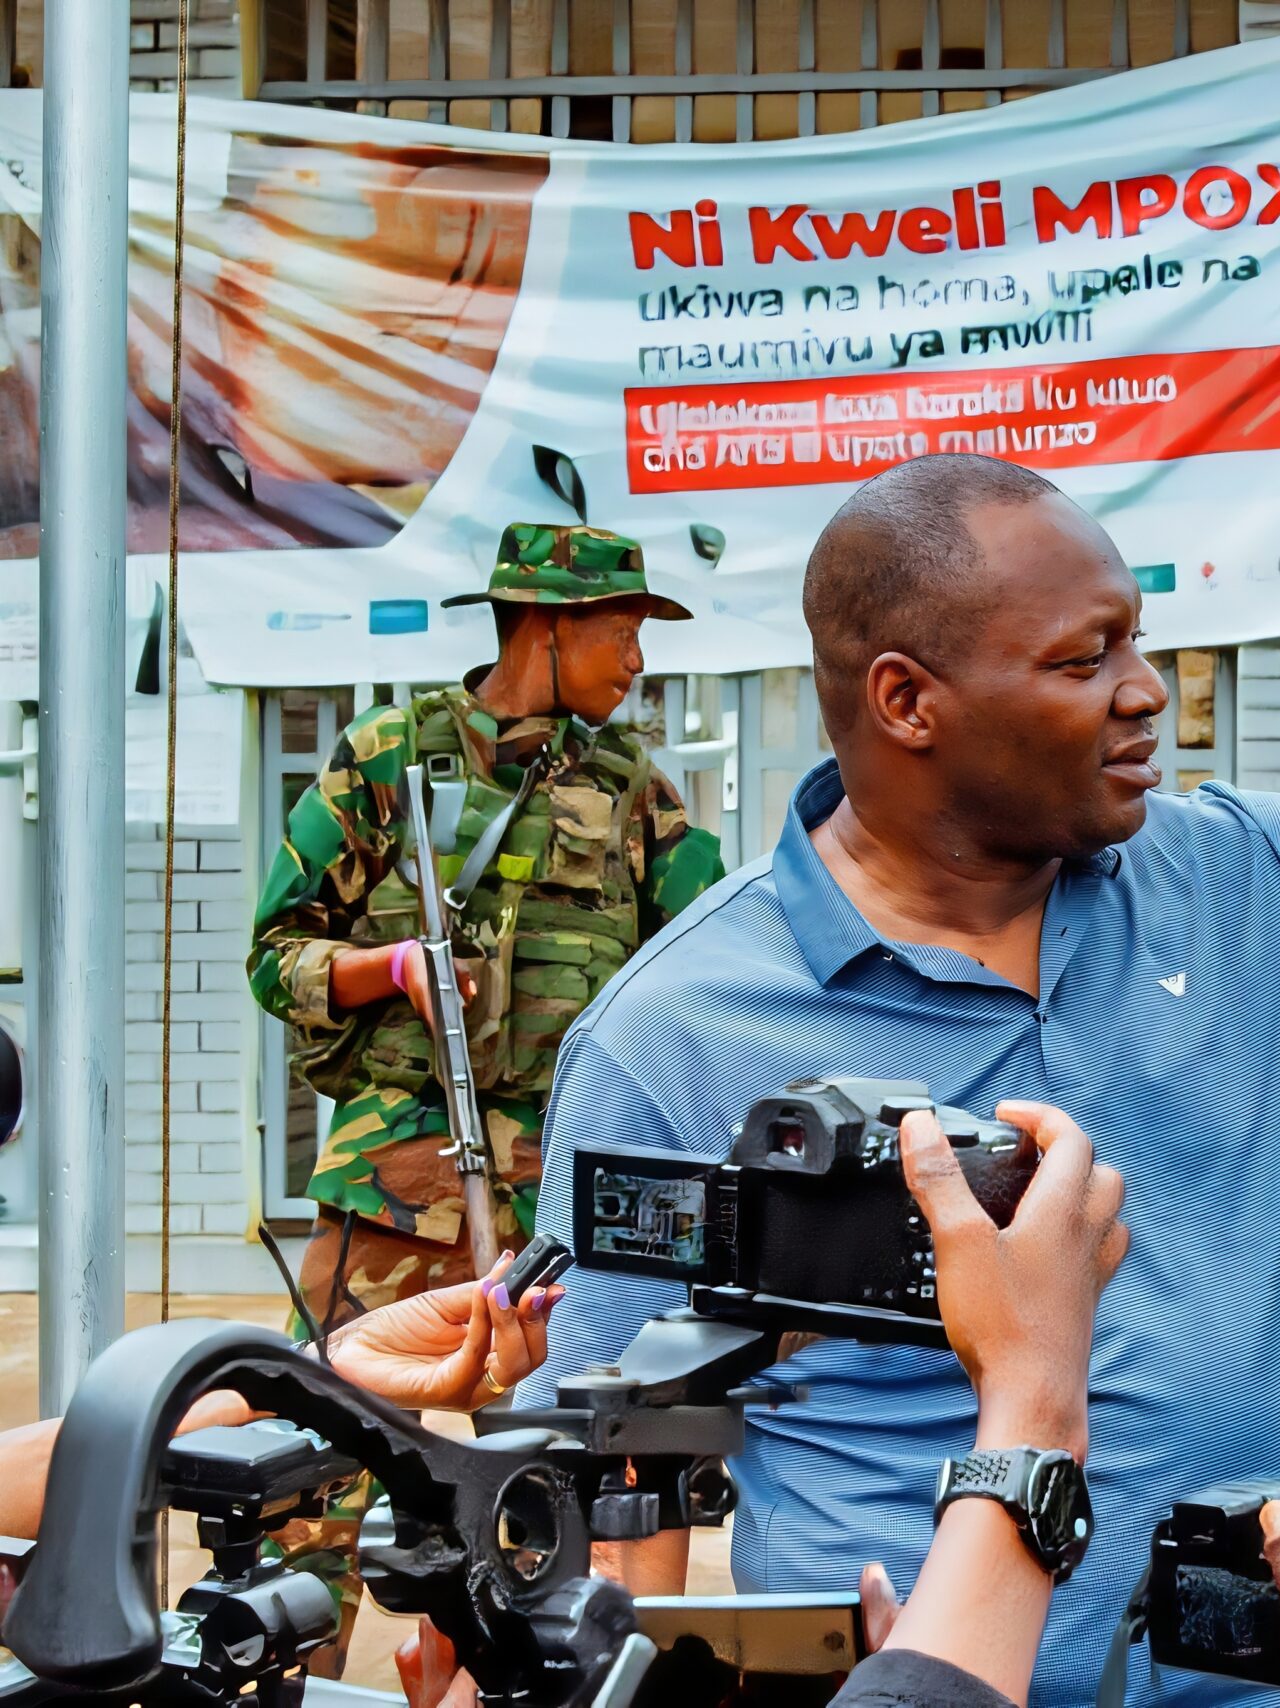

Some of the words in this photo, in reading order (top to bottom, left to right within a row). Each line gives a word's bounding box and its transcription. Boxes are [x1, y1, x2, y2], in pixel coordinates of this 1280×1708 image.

[629, 199, 723, 269] Ni
[748, 181, 1005, 263] Kweli
[803, 285, 859, 313] na
[1202, 255, 1262, 283] na
[890, 330, 945, 368] ya
